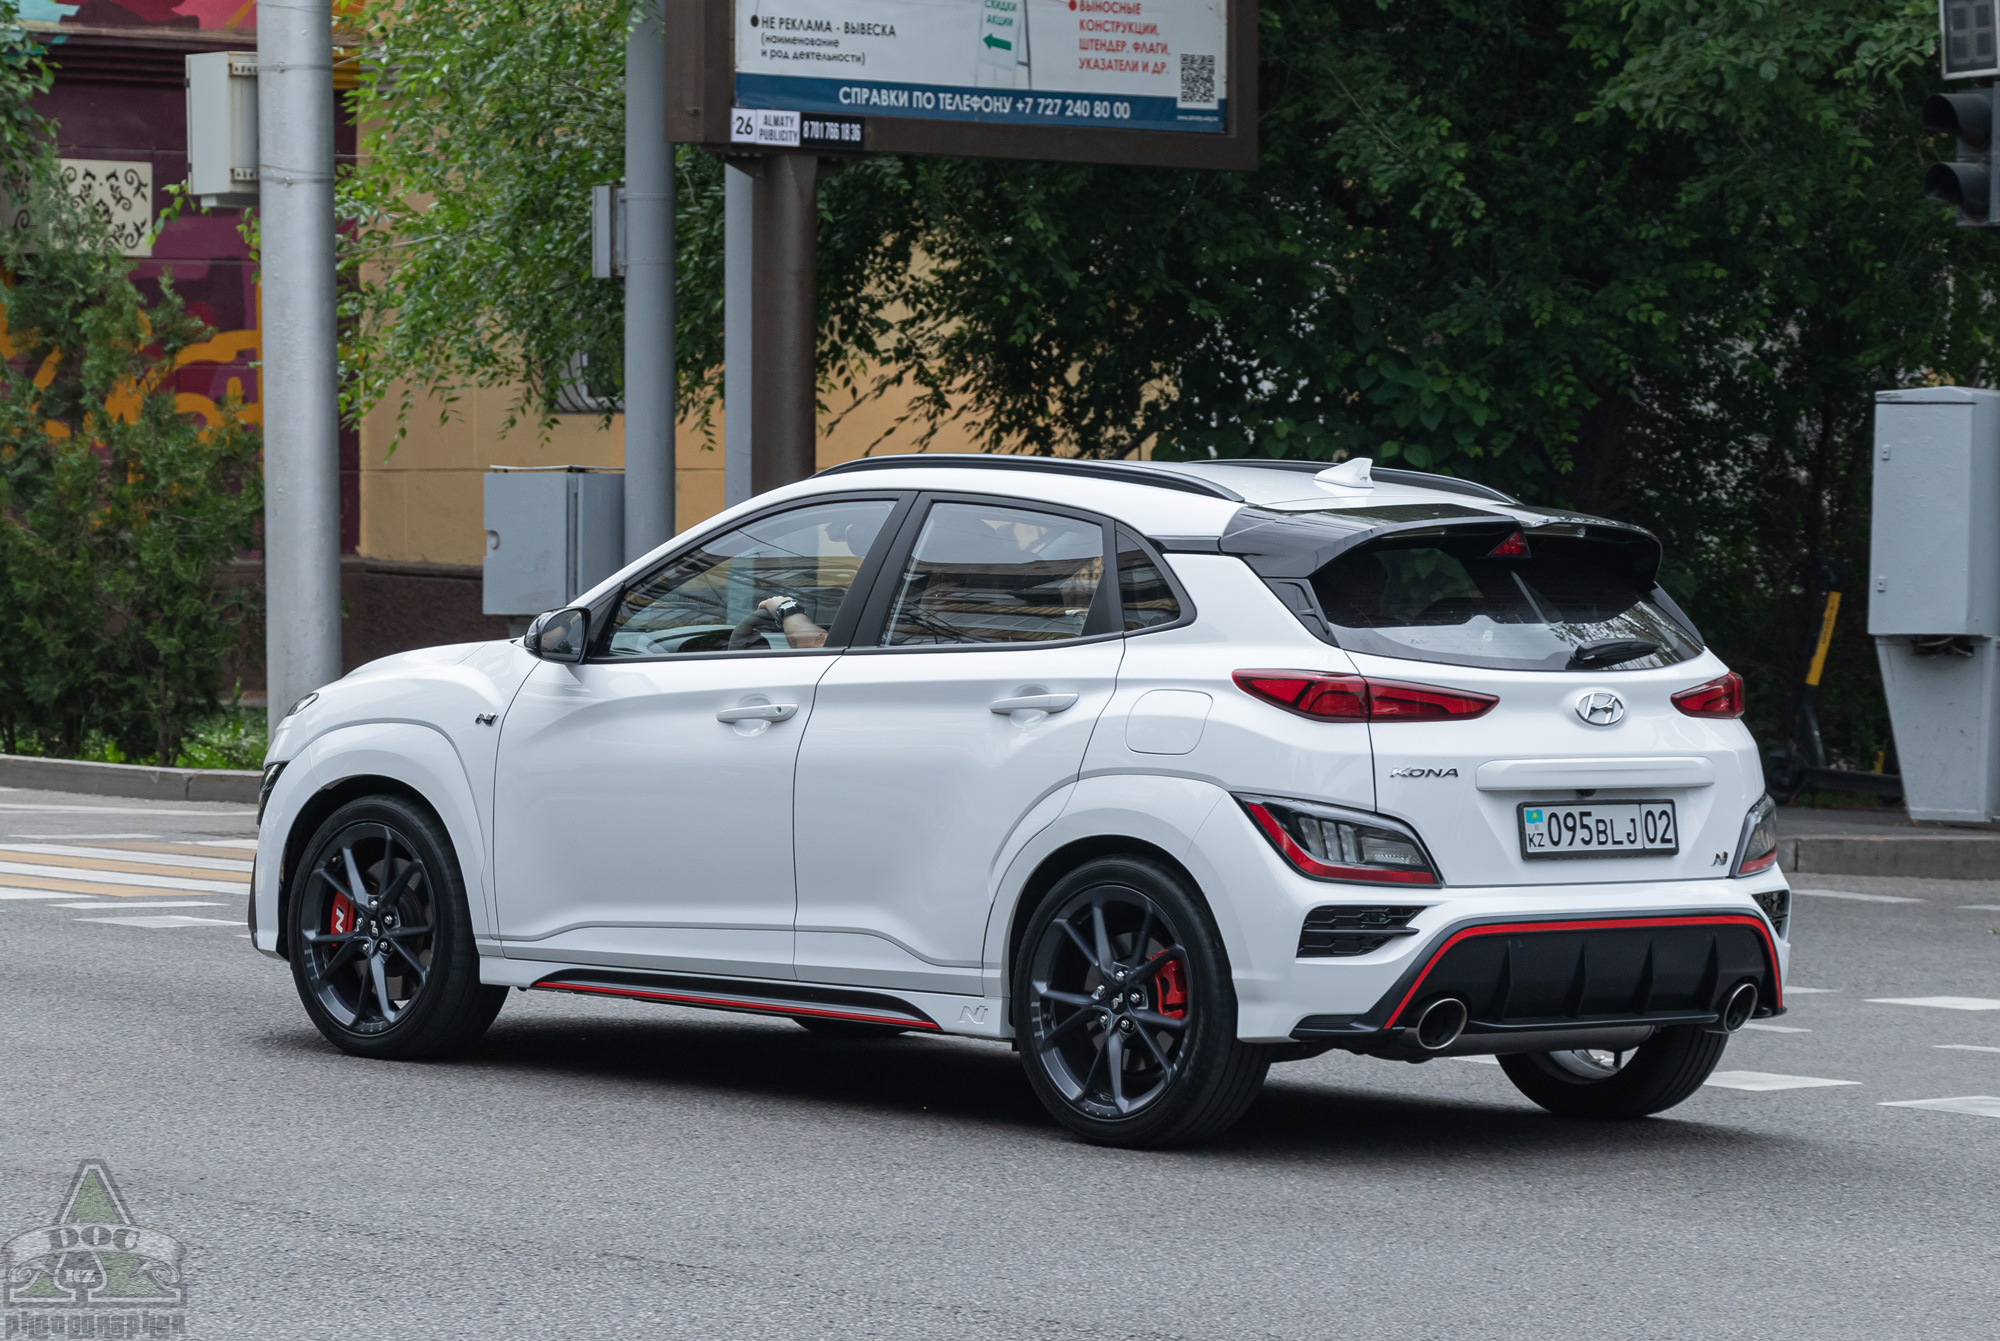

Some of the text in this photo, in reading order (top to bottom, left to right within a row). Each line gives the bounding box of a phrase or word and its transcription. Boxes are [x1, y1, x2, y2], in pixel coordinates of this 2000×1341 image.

[1079, 0, 1142, 15] ВЫНОСНЫЕ
[761, 16, 776, 30] НЕ
[779, 17, 833, 33] РЕКЛАМА
[844, 22, 897, 37] ВЫВЕСКА
[986, 14, 1014, 27] АКЦИИ
[761, 32, 840, 48] (наименование
[761, 49, 866, 65] и род деятельности)
[1079, 57, 1170, 75] УКАЗАТЕЛИ И ДР.
[838, 86, 1131, 120] СПРАВКИ ПО ТЕЛЕФОНУ +7 727 240 80 00
[735, 116, 754, 136] 26
[763, 114, 795, 127] ALMATY
[758, 128, 799, 143] PUBLICITY
[1389, 767, 1459, 778] KONA
[1528, 832, 1545, 848] KZ
[1644, 809, 1673, 844] 02
